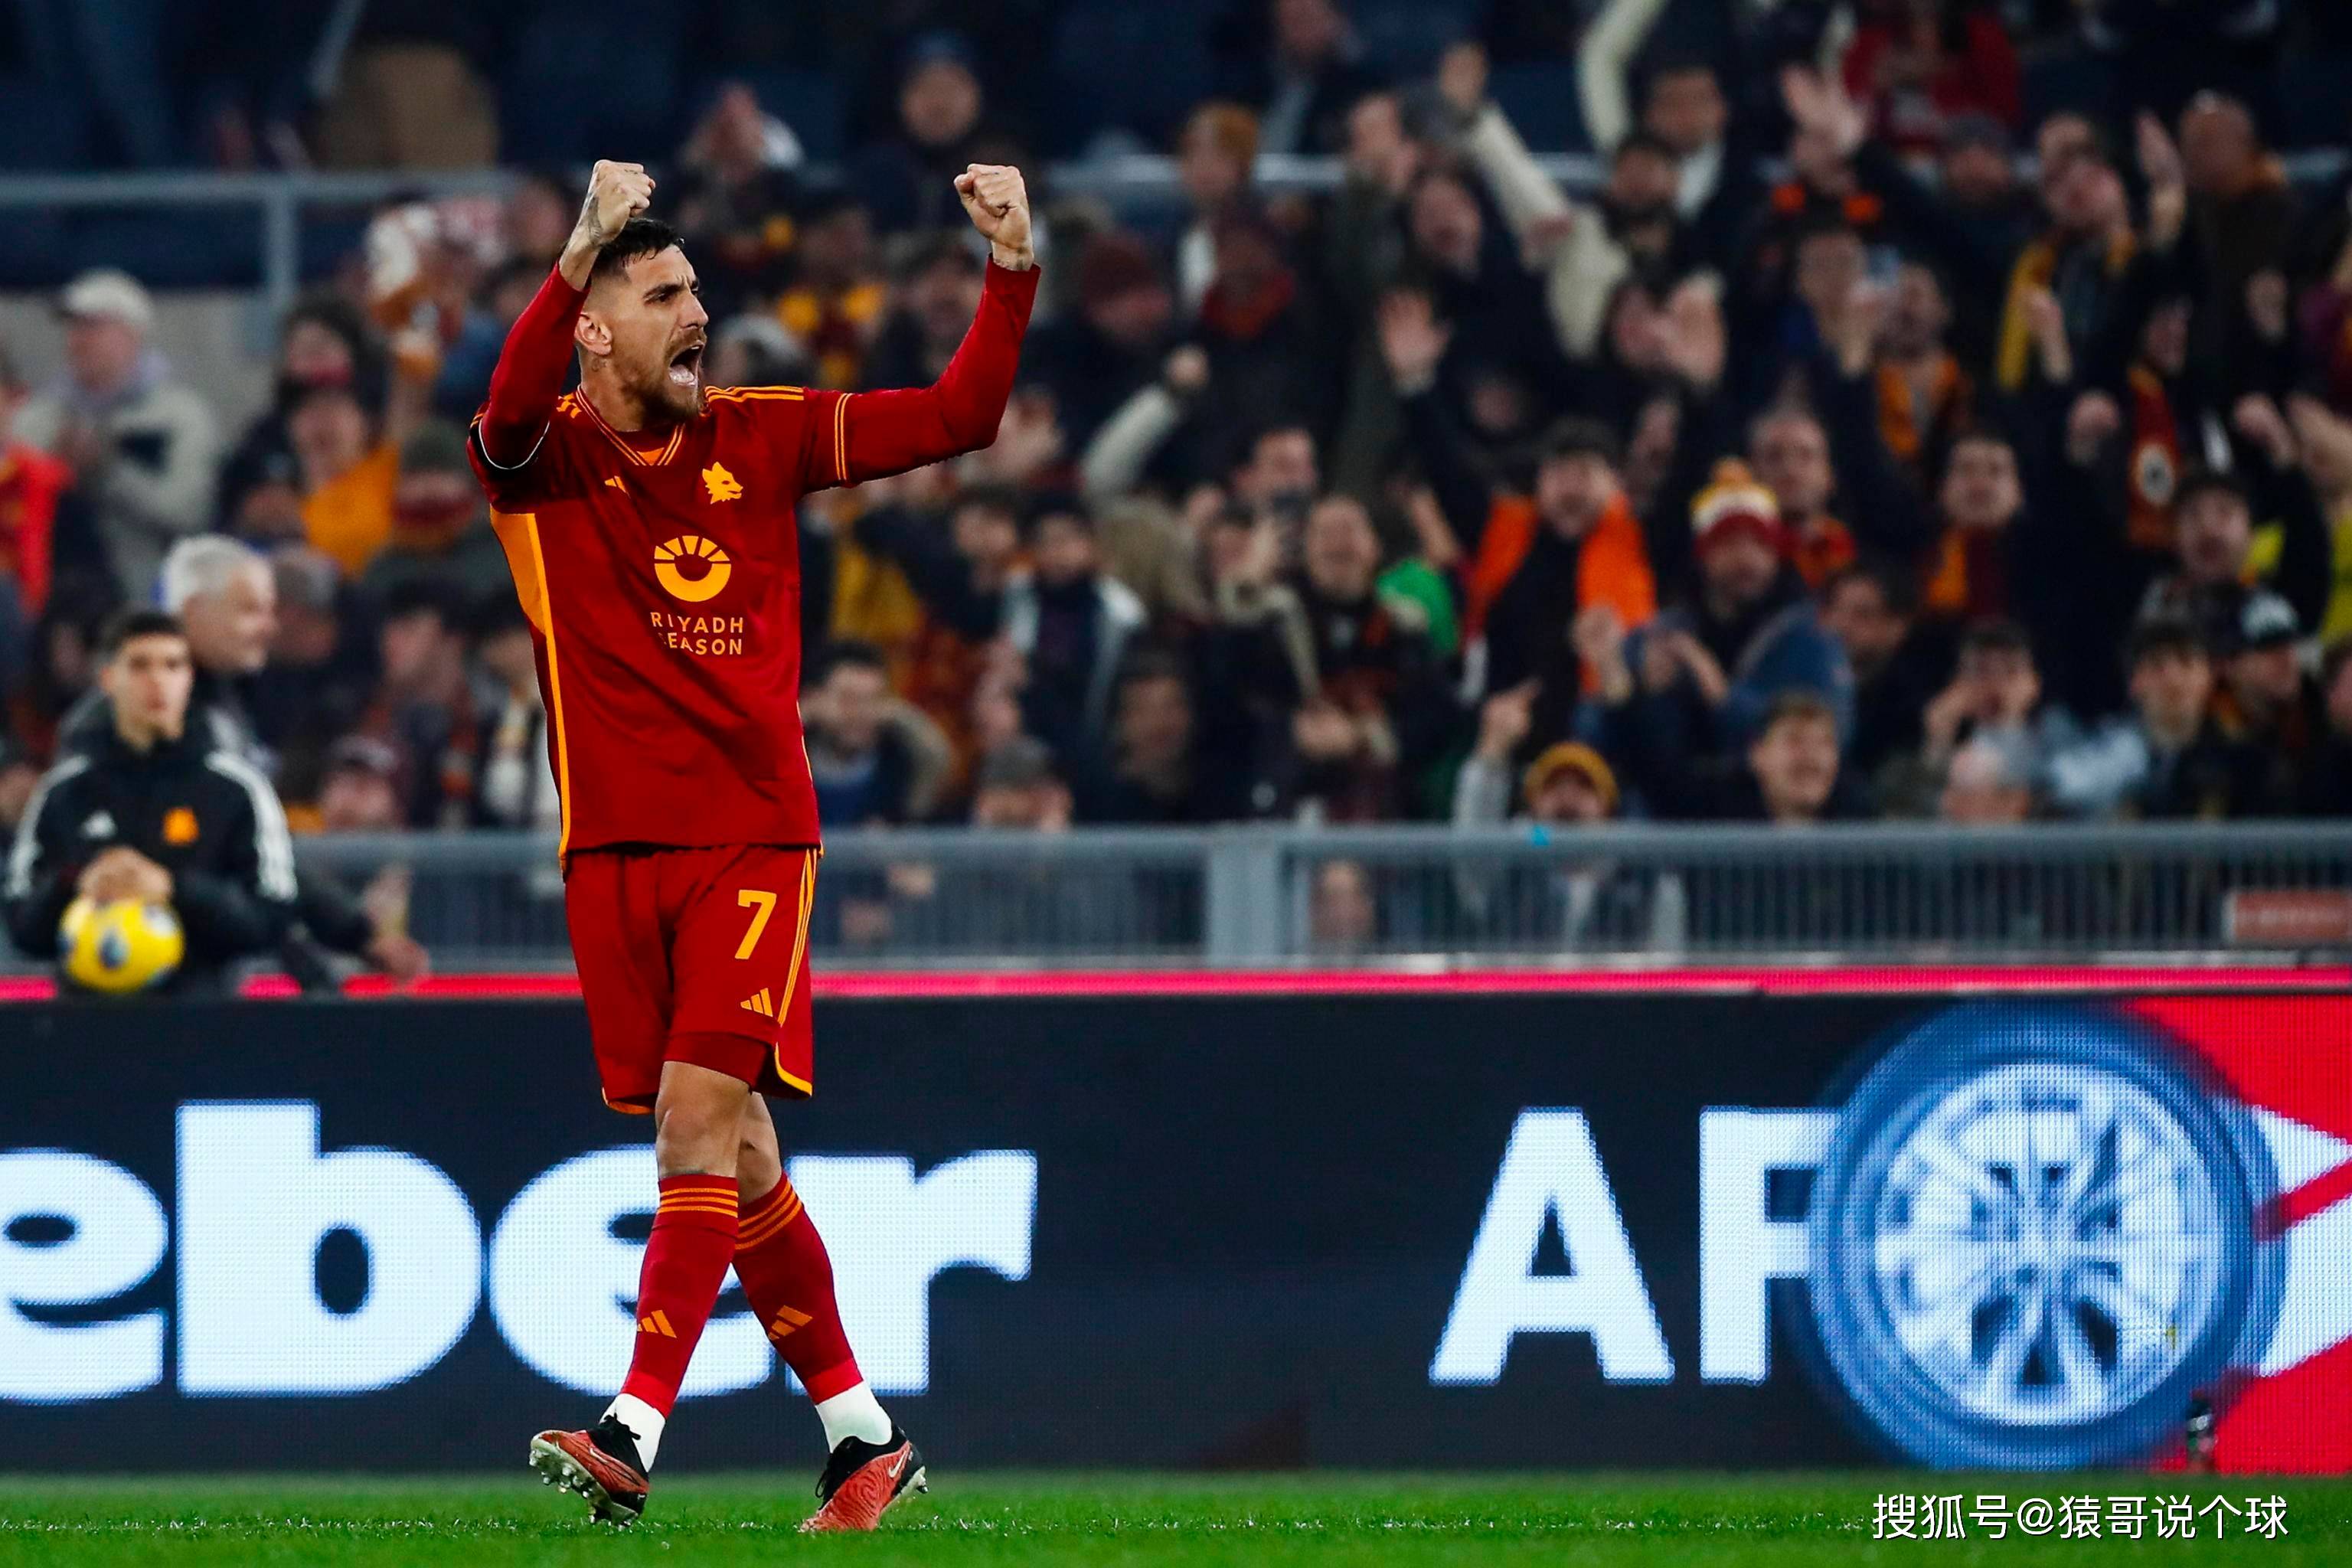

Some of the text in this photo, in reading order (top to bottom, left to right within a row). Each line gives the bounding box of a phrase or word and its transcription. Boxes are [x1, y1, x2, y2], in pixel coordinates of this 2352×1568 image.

[650, 612, 743, 634] RIYADH
[658, 632, 743, 655] EASON
[734, 889, 777, 960] 7
